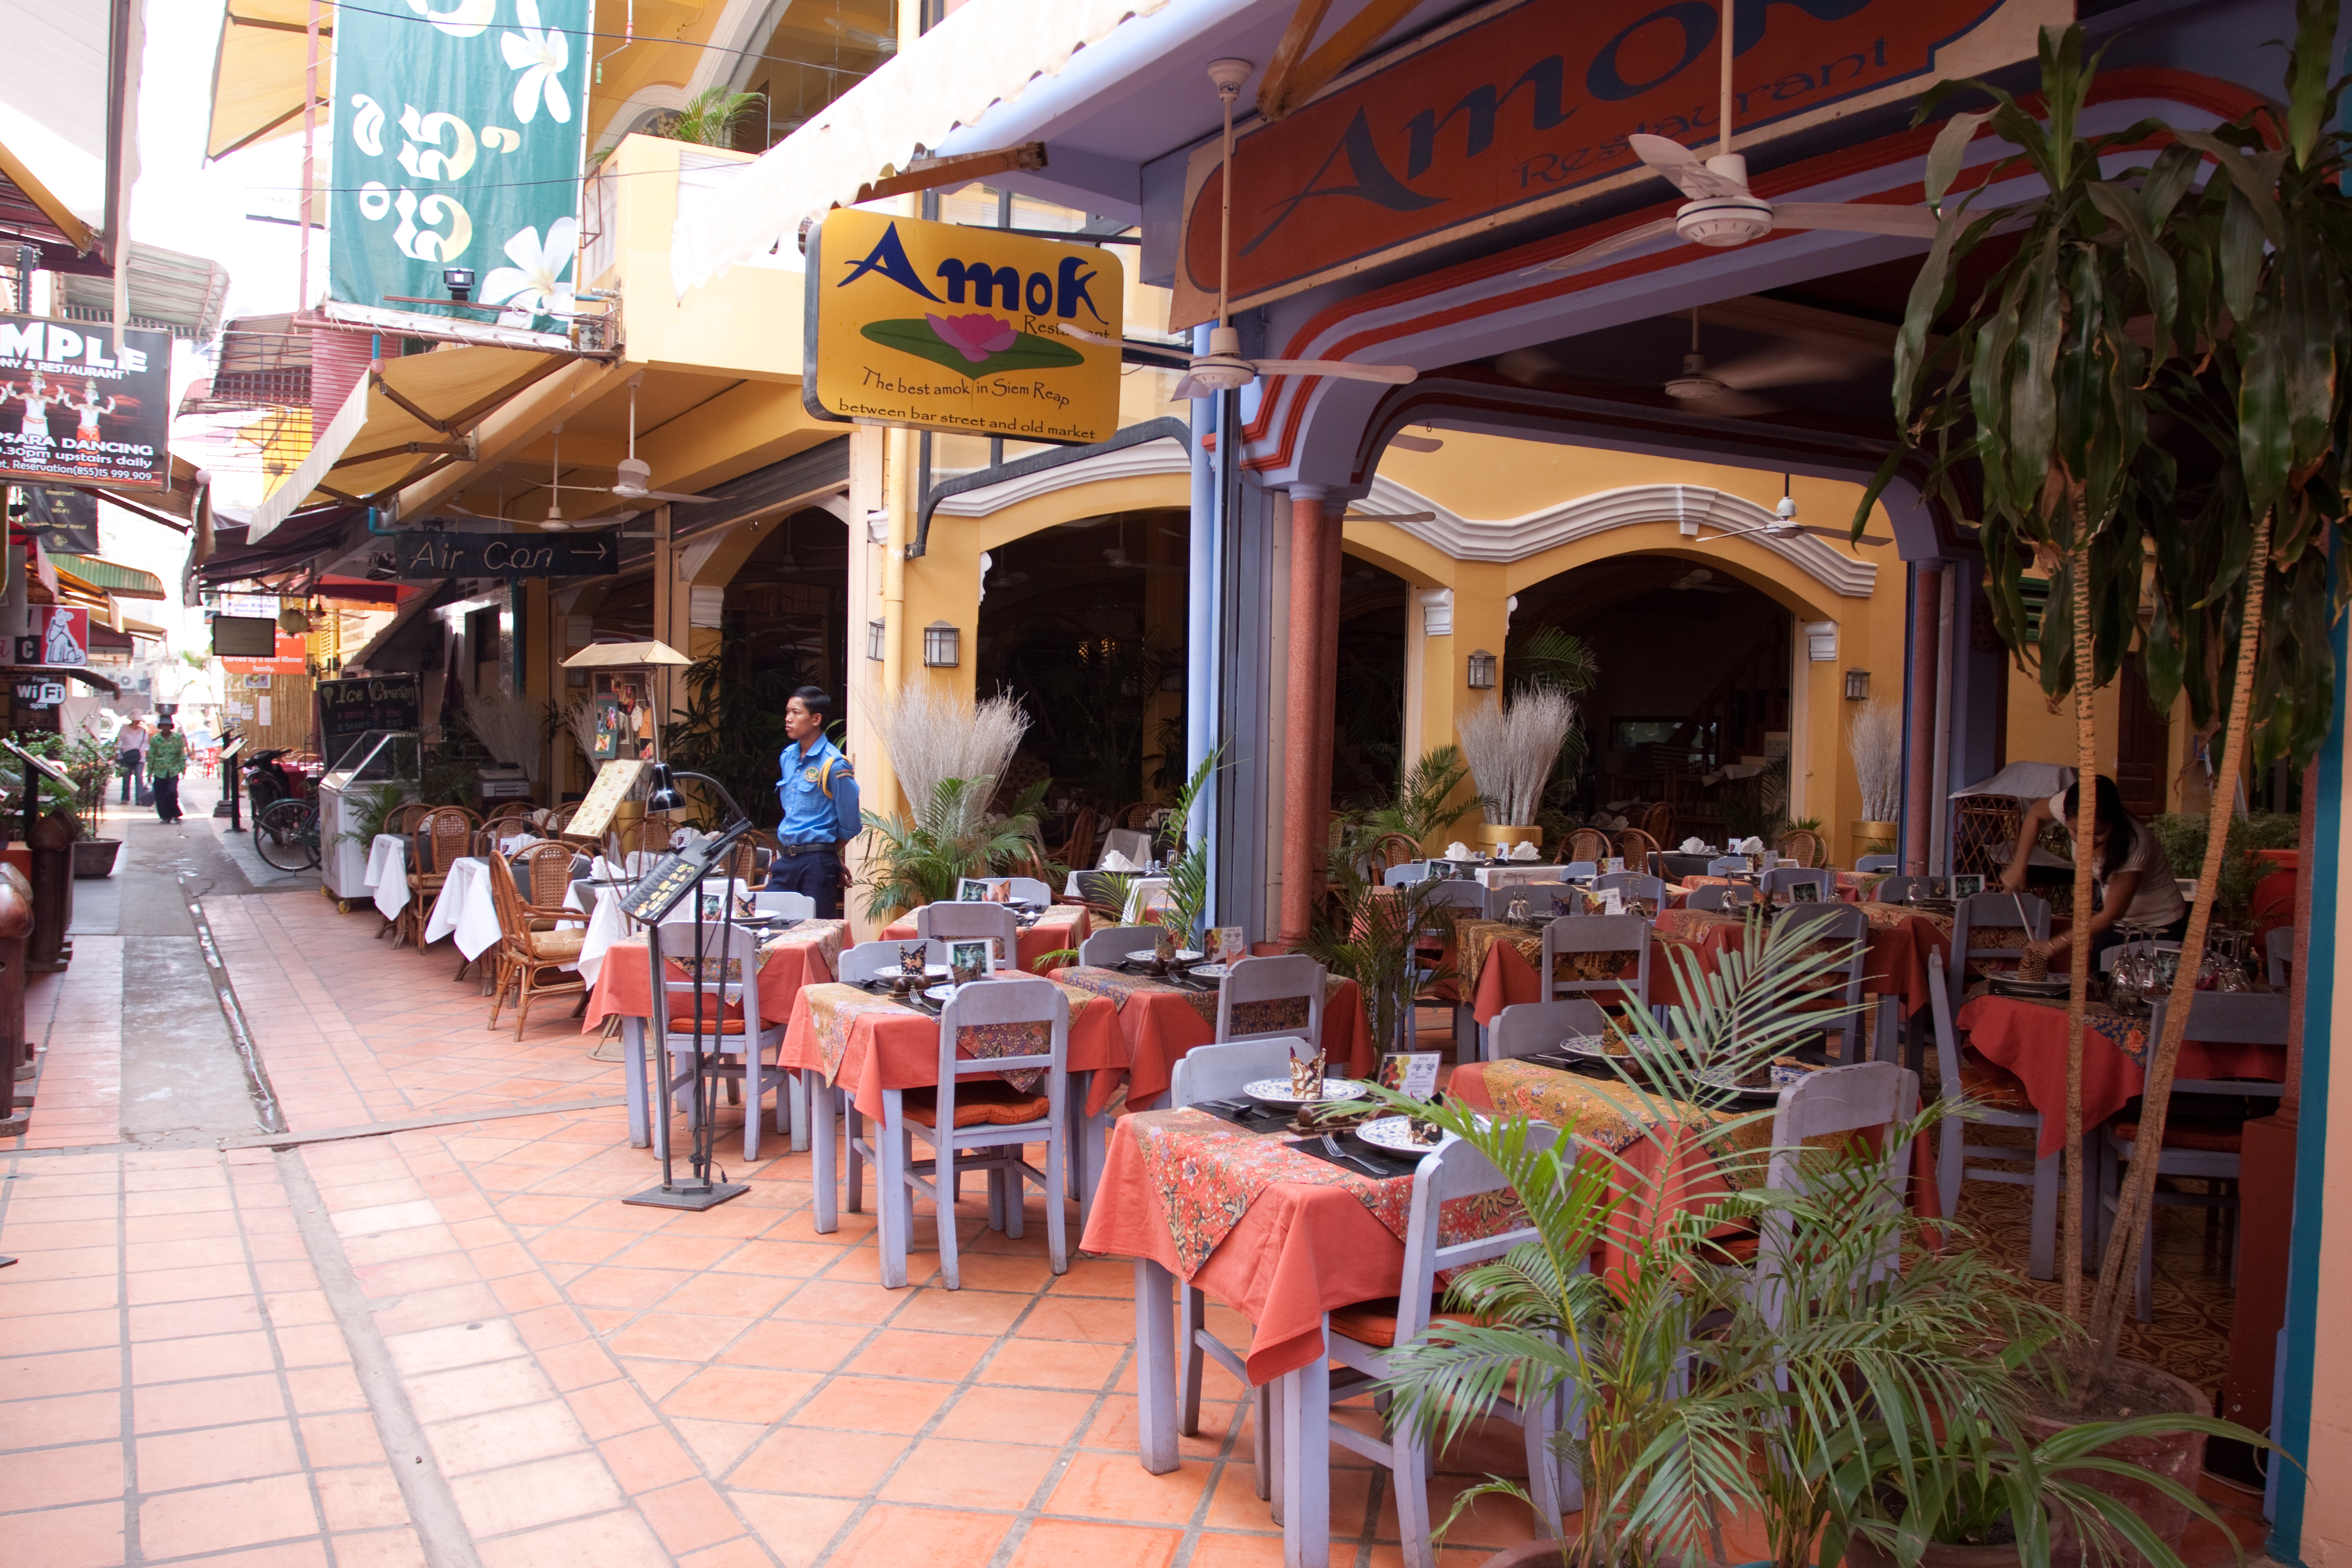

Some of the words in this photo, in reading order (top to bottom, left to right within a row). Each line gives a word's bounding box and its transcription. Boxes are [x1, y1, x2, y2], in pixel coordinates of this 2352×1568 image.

[1237, 0, 1877, 257] Amo
[836, 221, 1109, 325] Amok
[1024, 315, 1110, 339] Restnt
[0, 357, 22, 369] NY
[23, 360, 36, 371] &
[37, 361, 124, 380] RESTAURANT
[863, 366, 893, 391] The
[897, 377, 930, 394] best
[933, 378, 970, 394] amok
[977, 381, 988, 393] in
[991, 378, 1029, 396] Siem
[1033, 382, 1070, 409] Reap
[839, 397, 906, 417] between
[911, 406, 937, 421] bar
[940, 414, 985, 427] street
[989, 418, 1017, 430] and
[1021, 419, 1043, 433] old
[1048, 424, 1095, 439] market
[61, 438, 154, 456] DANCING
[55, 451, 112, 464] upstairs
[115, 455, 152, 469] daily
[110, 469, 130, 479] 999
[132, 471, 152, 481] 909
[409, 541, 464, 570] Air
[484, 541, 553, 570] Con
[336, 684, 364, 704] Ice
[370, 681, 416, 706] Cream
